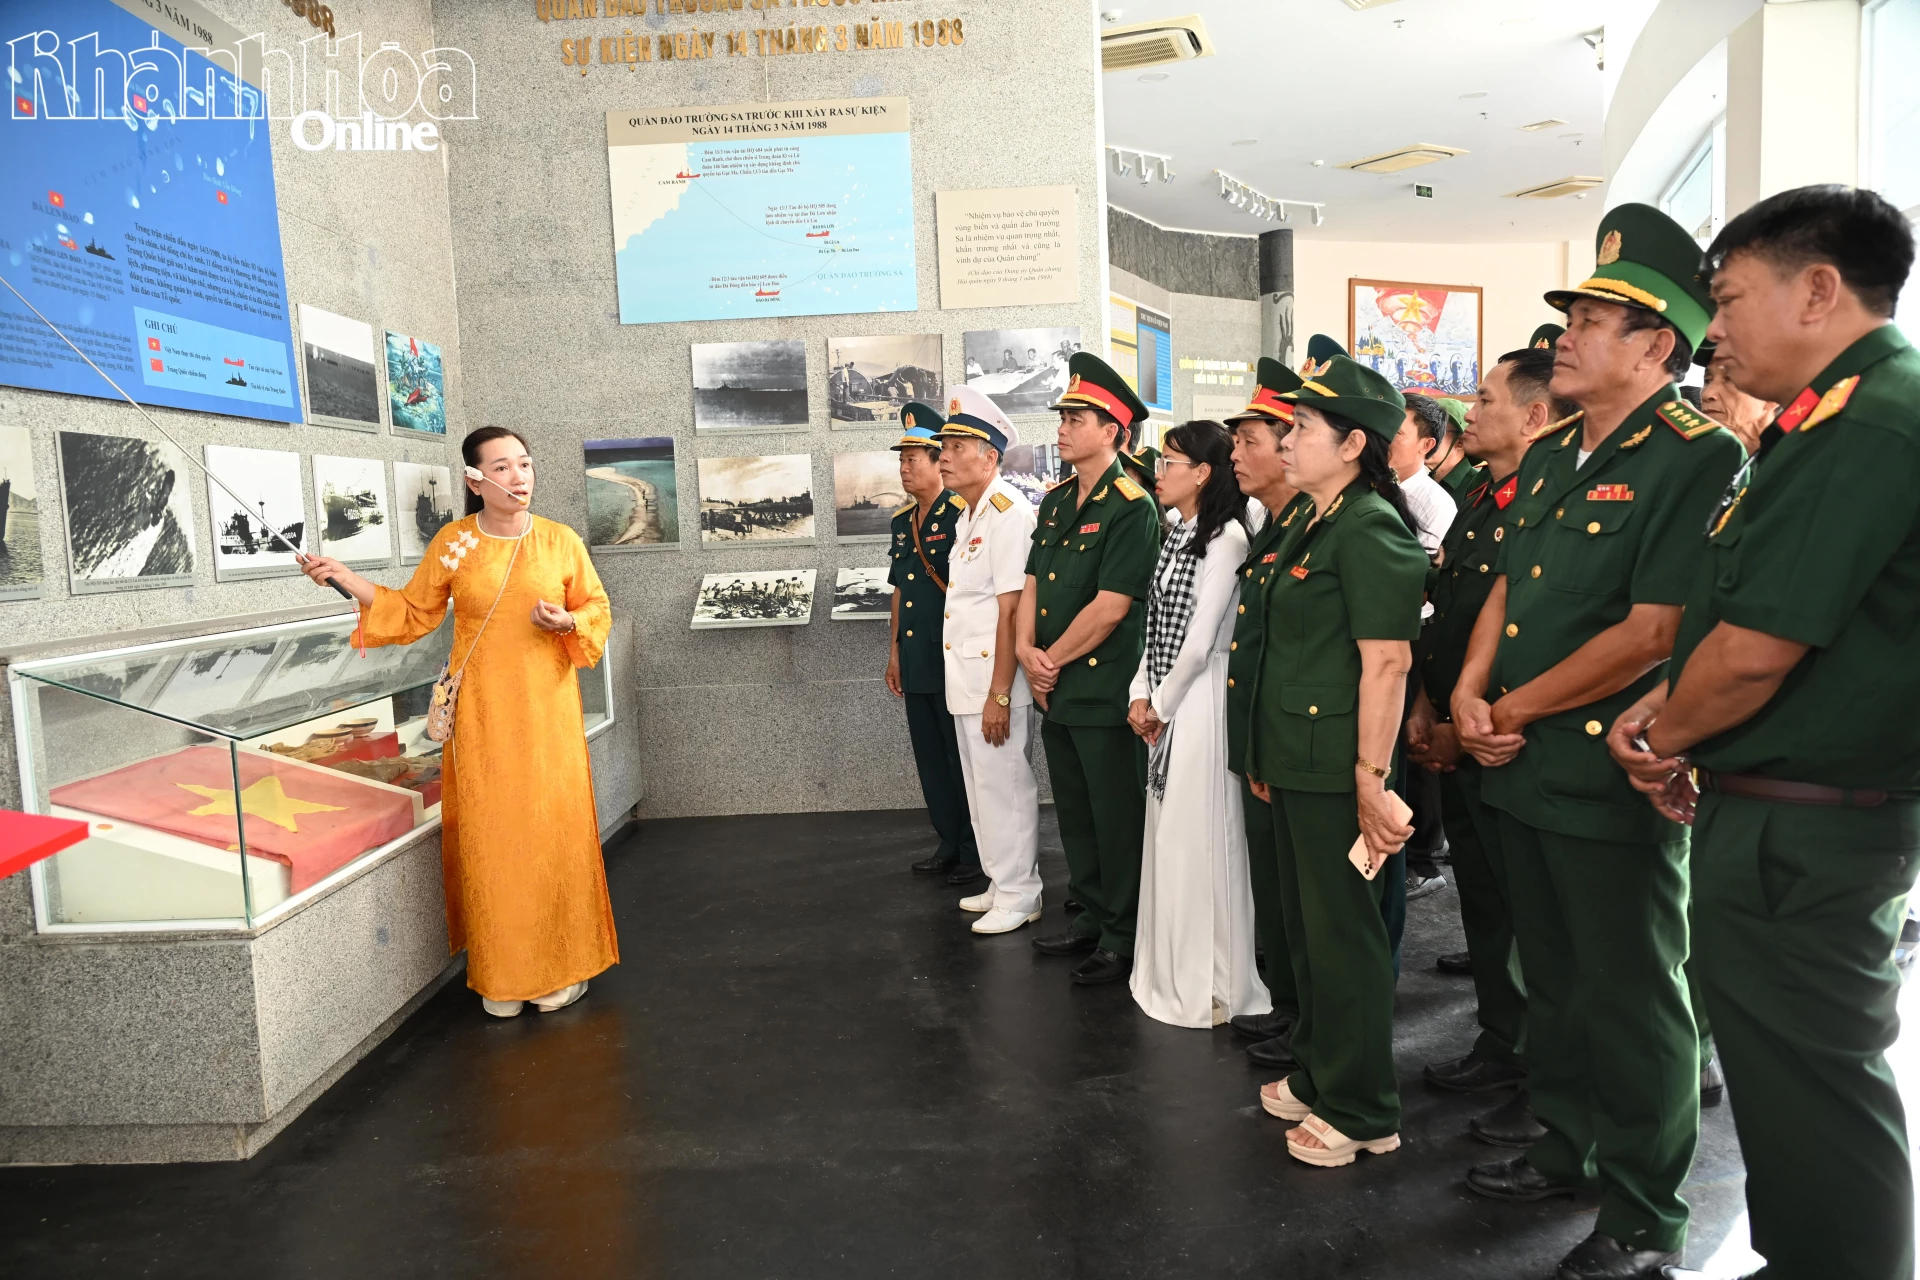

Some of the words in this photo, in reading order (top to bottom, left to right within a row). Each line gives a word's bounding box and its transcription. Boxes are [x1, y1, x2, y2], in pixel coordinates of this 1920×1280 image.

[156, 0, 162, 12] 3
[164, 2, 190, 31] NĂM
[192, 23, 213, 45] 1988
[562, 36, 591, 75] SỰ
[600, 30, 652, 72] KIỆN
[659, 25, 714, 61] NGÀY
[726, 31, 748, 57] 14
[756, 21, 828, 57] THÁNG
[836, 24, 848, 51] 3
[856, 16, 904, 50] NĂM
[910, 18, 964, 47] 1988
[629, 114, 658, 127] QUẦN
[660, 114, 682, 125] ĐẢO
[684, 112, 728, 123] TRƯỜNG
[731, 113, 743, 121] SA
[745, 109, 781, 120] TRƯỚC
[784, 110, 802, 119] KHI
[806, 107, 826, 117] XẢY
[829, 108, 843, 116] RA
[846, 106, 859, 117] SỰ
[861, 105, 887, 116] KIỆN
[692, 125, 721, 135] NGÀY
[735, 123, 771, 133] THÁNG
[781, 121, 804, 130] NĂM
[808, 122, 827, 130] 1988
[1039, 206, 1059, 218] quyền
[955, 224, 971, 232] vùng
[974, 222, 988, 230] biển
[1002, 221, 1018, 230] quần
[1035, 219, 1059, 228] Trường
[974, 233, 994, 242] nhiệm
[1006, 232, 1022, 240] quan
[1025, 230, 1042, 240] trọng
[956, 245, 972, 253] khẩn
[976, 244, 998, 253] trương
[1003, 242, 1016, 250] nhất
[1034, 241, 1050, 250] cũng
[973, 255, 982, 264] dự
[997, 254, 1014, 263] Quân
[818, 272, 839, 280] QUẦN
[859, 269, 891, 278] TRƯỜNG
[145, 319, 159, 330] GHI
[162, 322, 177, 334] CHÚ
